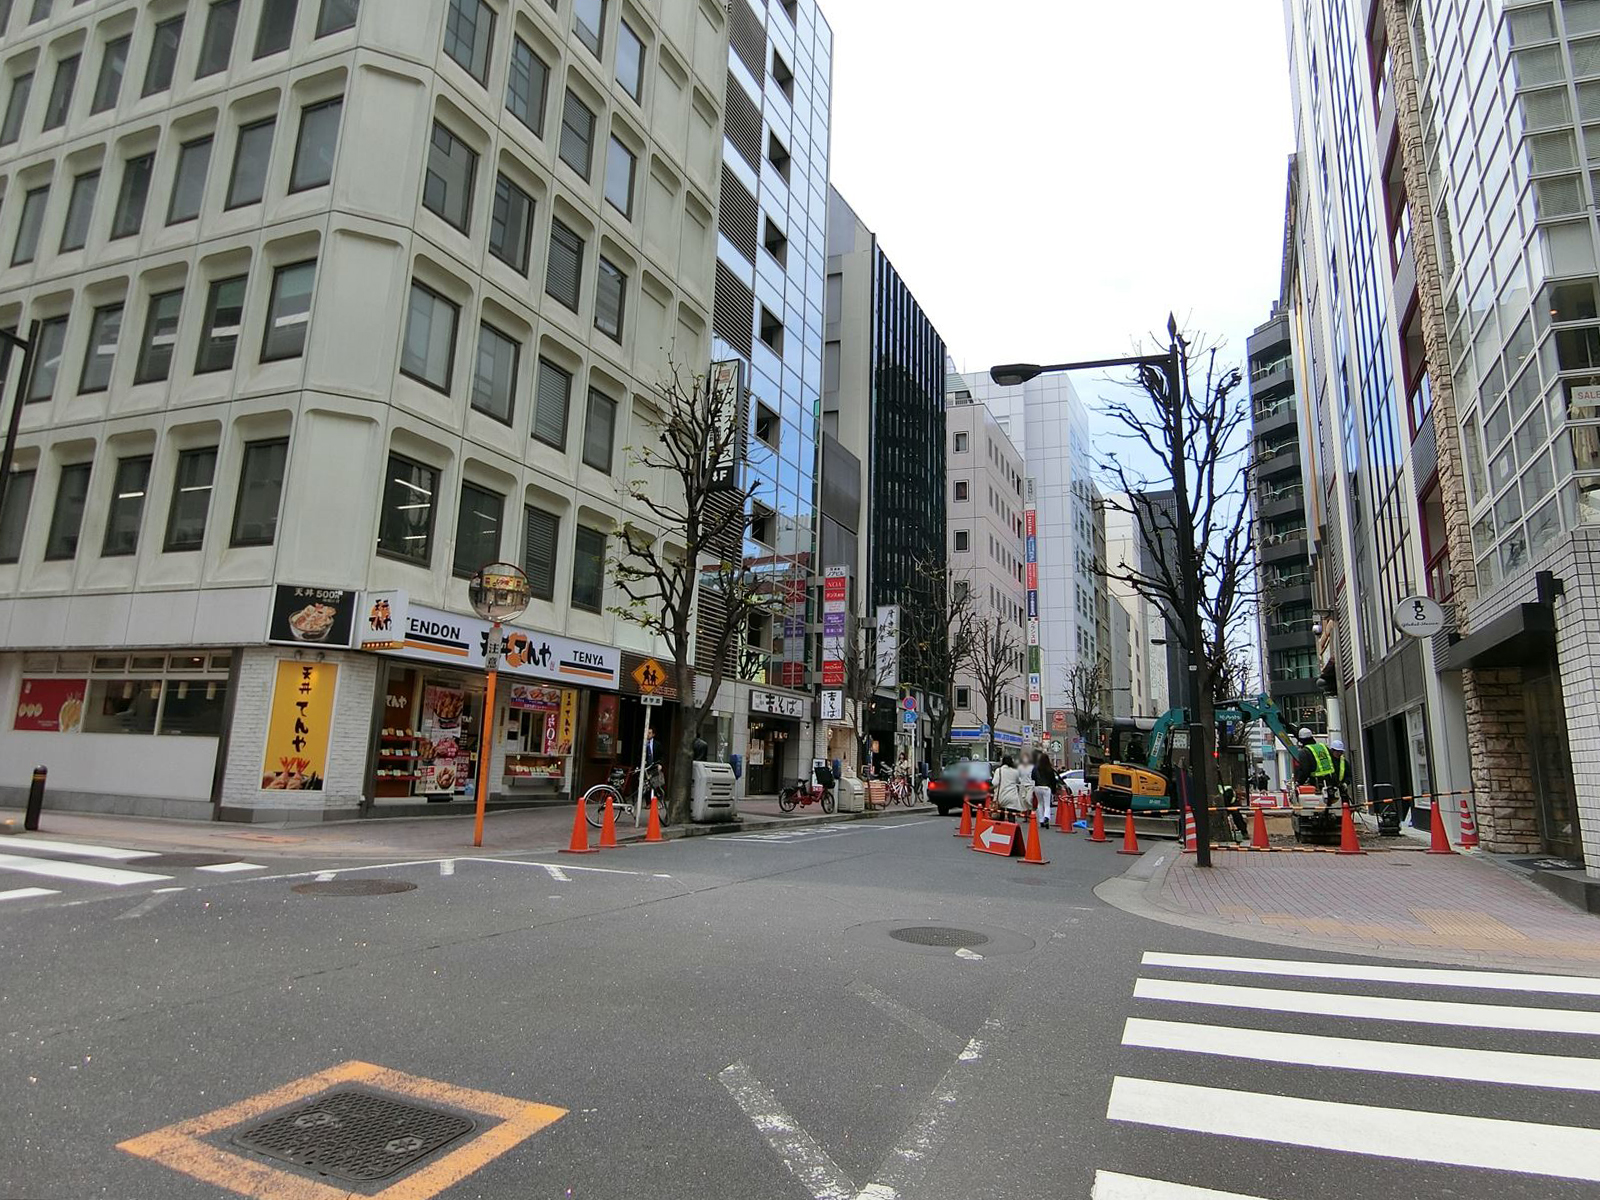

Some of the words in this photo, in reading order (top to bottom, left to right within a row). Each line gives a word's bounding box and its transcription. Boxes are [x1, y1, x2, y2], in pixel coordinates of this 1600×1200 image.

[406, 617, 460, 640] ENDON
[573, 650, 604, 667] TENYA
[386, 695, 407, 709] てんや
[765, 693, 797, 714] 吉そば
[905, 714, 911, 723] P
